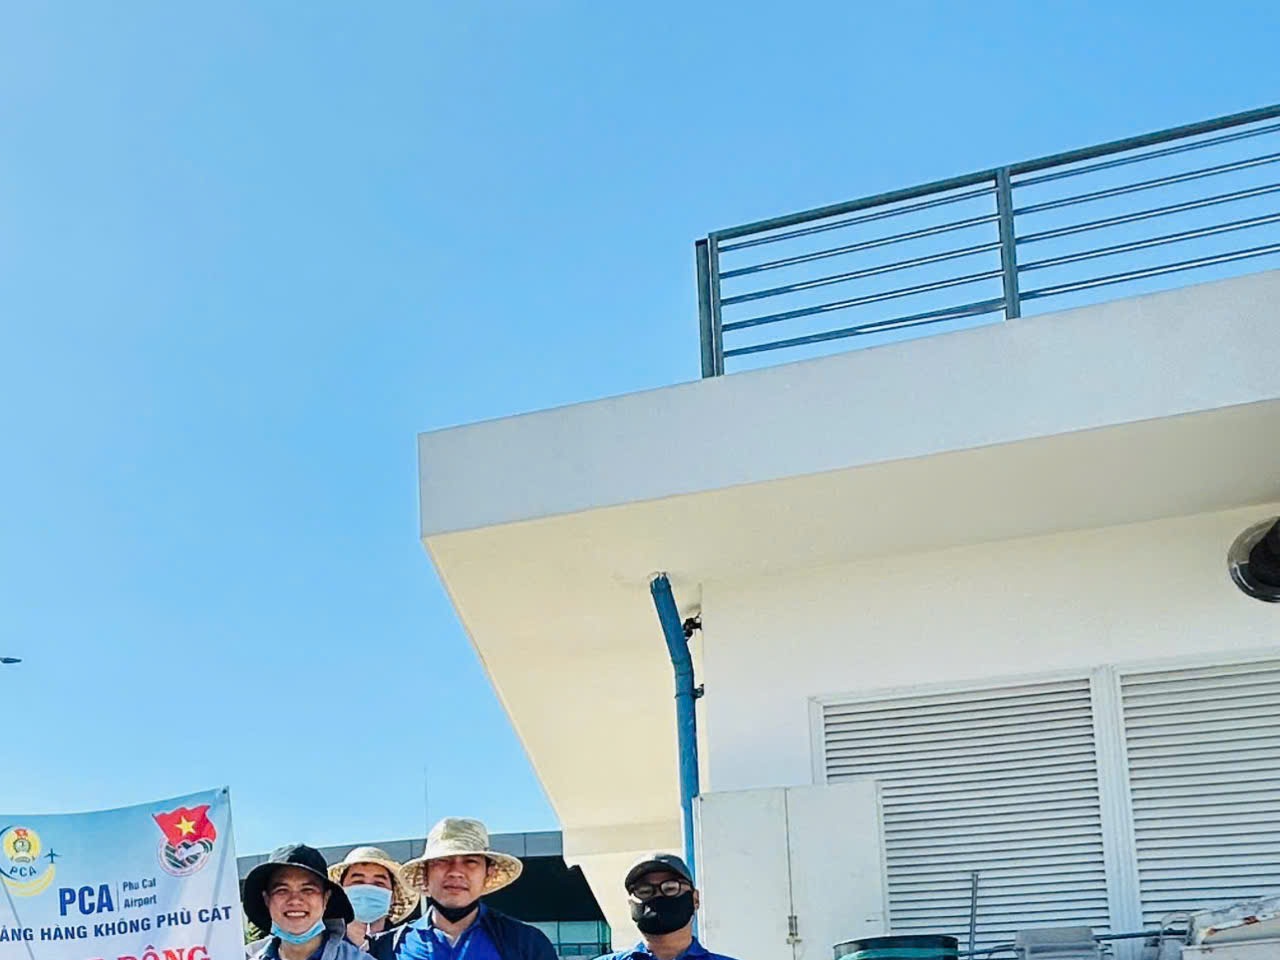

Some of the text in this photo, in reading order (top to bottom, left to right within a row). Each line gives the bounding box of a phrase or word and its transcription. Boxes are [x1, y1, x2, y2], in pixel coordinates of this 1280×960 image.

[9, 866, 37, 877] PCA
[59, 884, 114, 916] PCA
[124, 894, 157, 909] Airport
[40, 923, 87, 941] HÀNG
[94, 917, 151, 937] KHÔNG
[156, 907, 191, 928] PHÙ
[198, 903, 232, 923] CÁT
